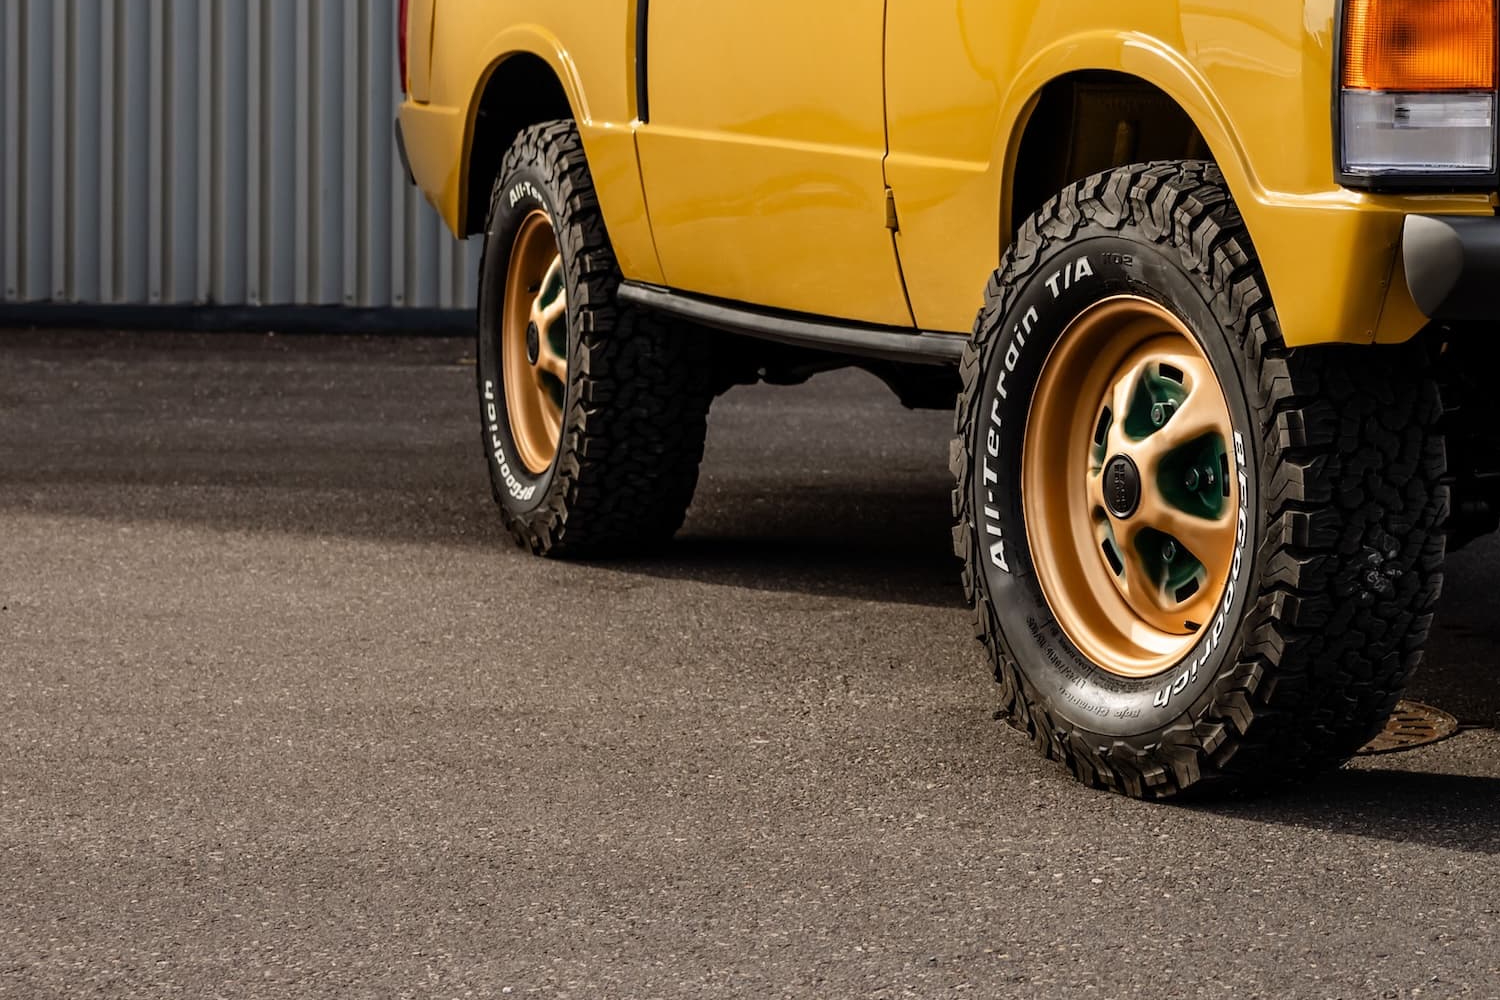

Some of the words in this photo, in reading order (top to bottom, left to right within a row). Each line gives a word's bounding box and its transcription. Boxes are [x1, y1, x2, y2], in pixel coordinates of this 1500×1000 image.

[484, 379, 537, 502] BFGoodrich
[982, 304, 1040, 575] All-Terrain
[1044, 254, 1094, 299] T/A
[1152, 430, 1249, 709] BFGoodrich
